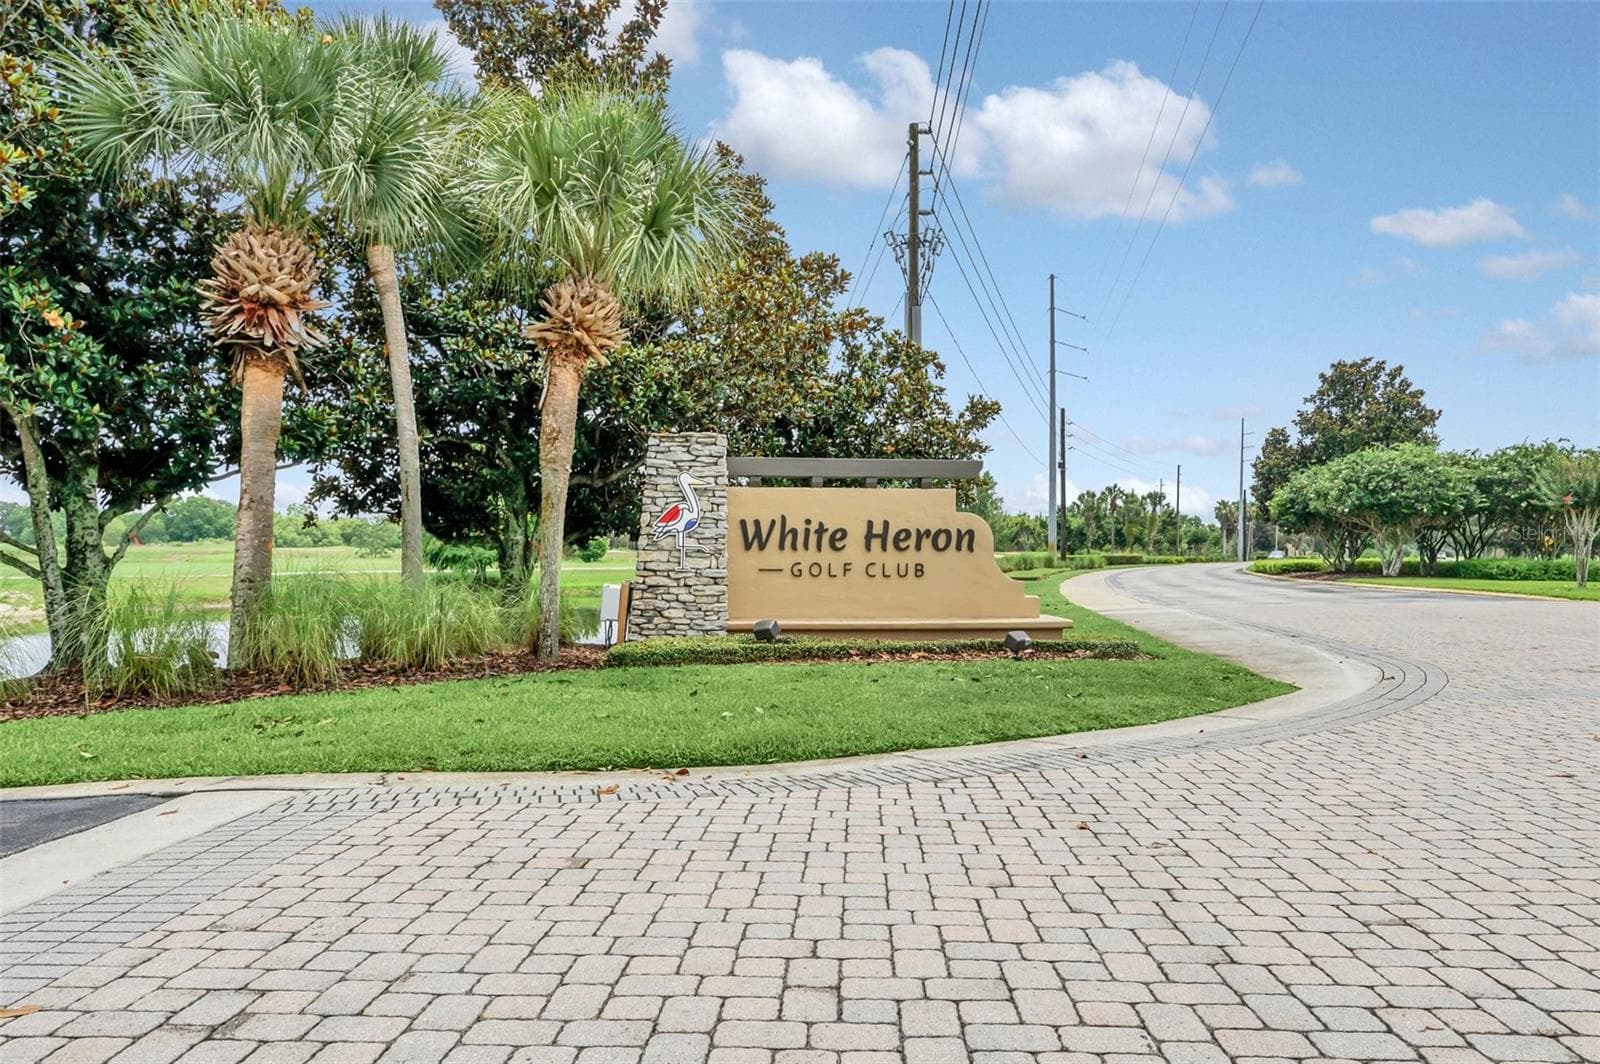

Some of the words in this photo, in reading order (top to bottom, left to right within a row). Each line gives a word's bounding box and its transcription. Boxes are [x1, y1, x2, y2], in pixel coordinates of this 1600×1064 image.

[739, 514, 848, 552] White
[864, 519, 976, 553] Heron
[790, 561, 853, 578] GOLF
[865, 561, 925, 578] CLUB
